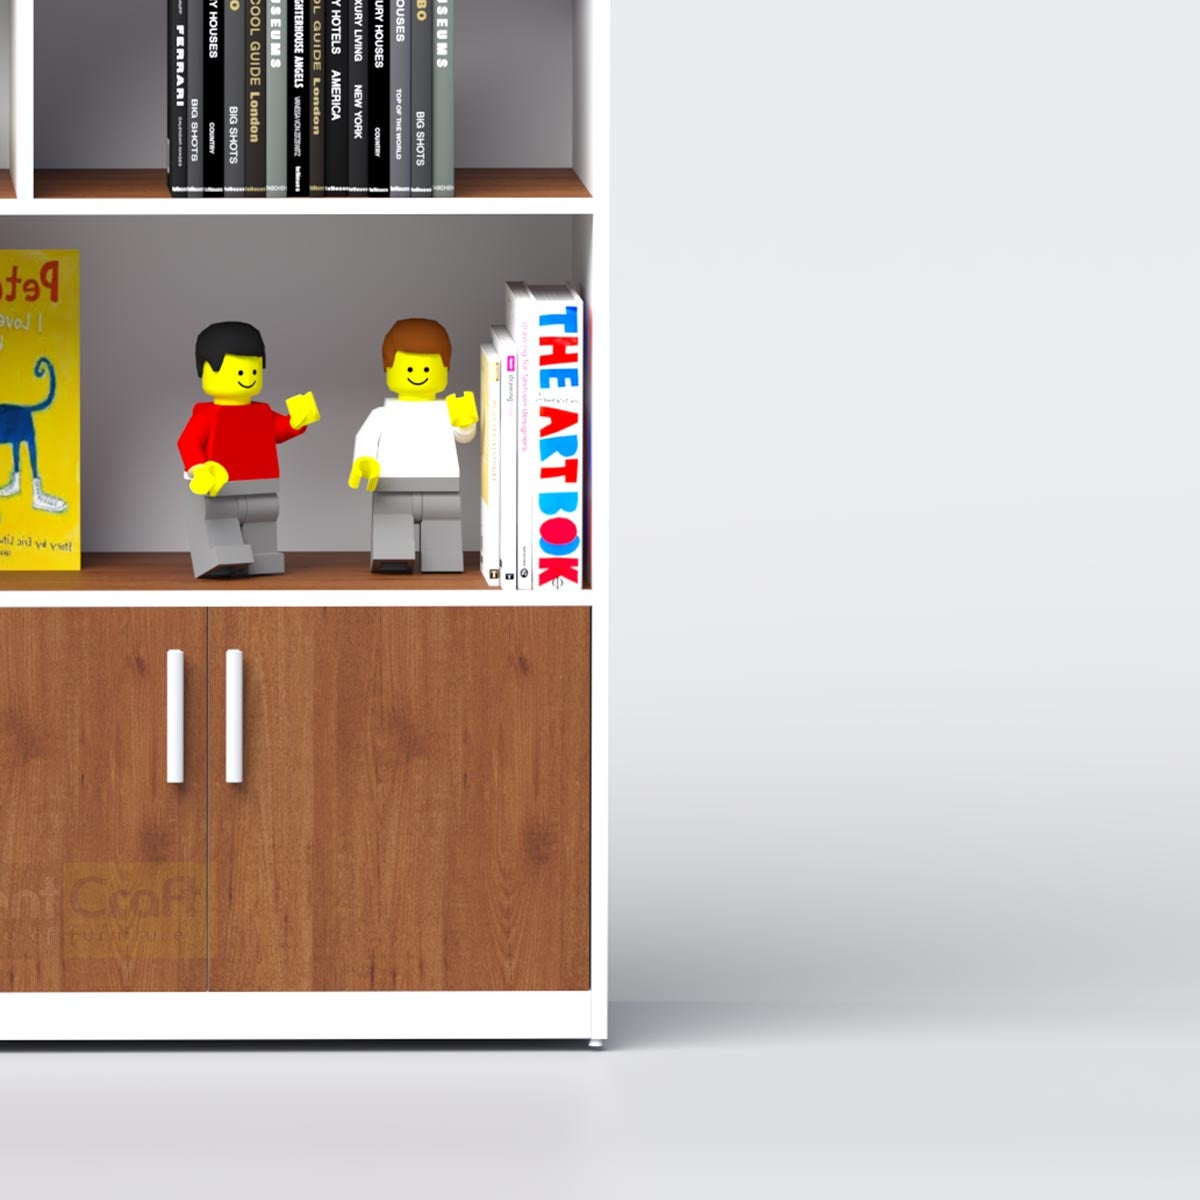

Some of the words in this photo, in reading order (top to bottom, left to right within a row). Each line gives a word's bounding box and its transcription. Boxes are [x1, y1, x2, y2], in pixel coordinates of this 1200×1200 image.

[208, 12, 218, 58] HOUSES
[313, 20, 321, 70] GUIDE
[331, 10, 341, 54] HOTELS
[354, 29, 362, 62] LIVING
[374, 24, 384, 68] HOUSES
[176, 25, 184, 106] FERRARI
[250, 41, 260, 86] GUIDE
[294, 56, 304, 88] ANGELS
[190, 98, 198, 118] BIG
[229, 106, 238, 124] BIG
[250, 92, 260, 142] London
[313, 77, 321, 135] London
[331, 70, 341, 120] AMERICA
[354, 84, 362, 108] NEW
[396, 105, 402, 115] OF
[354, 110, 362, 139] YORK
[416, 111, 425, 128] BIG
[190, 122, 198, 162] SHOTS
[229, 127, 238, 164] SHOTS
[416, 131, 425, 166] SHOTS
[538, 306, 579, 389] THE
[520, 408, 530, 452] designers
[538, 406, 579, 483] ART
[538, 492, 580, 586] BOOK
